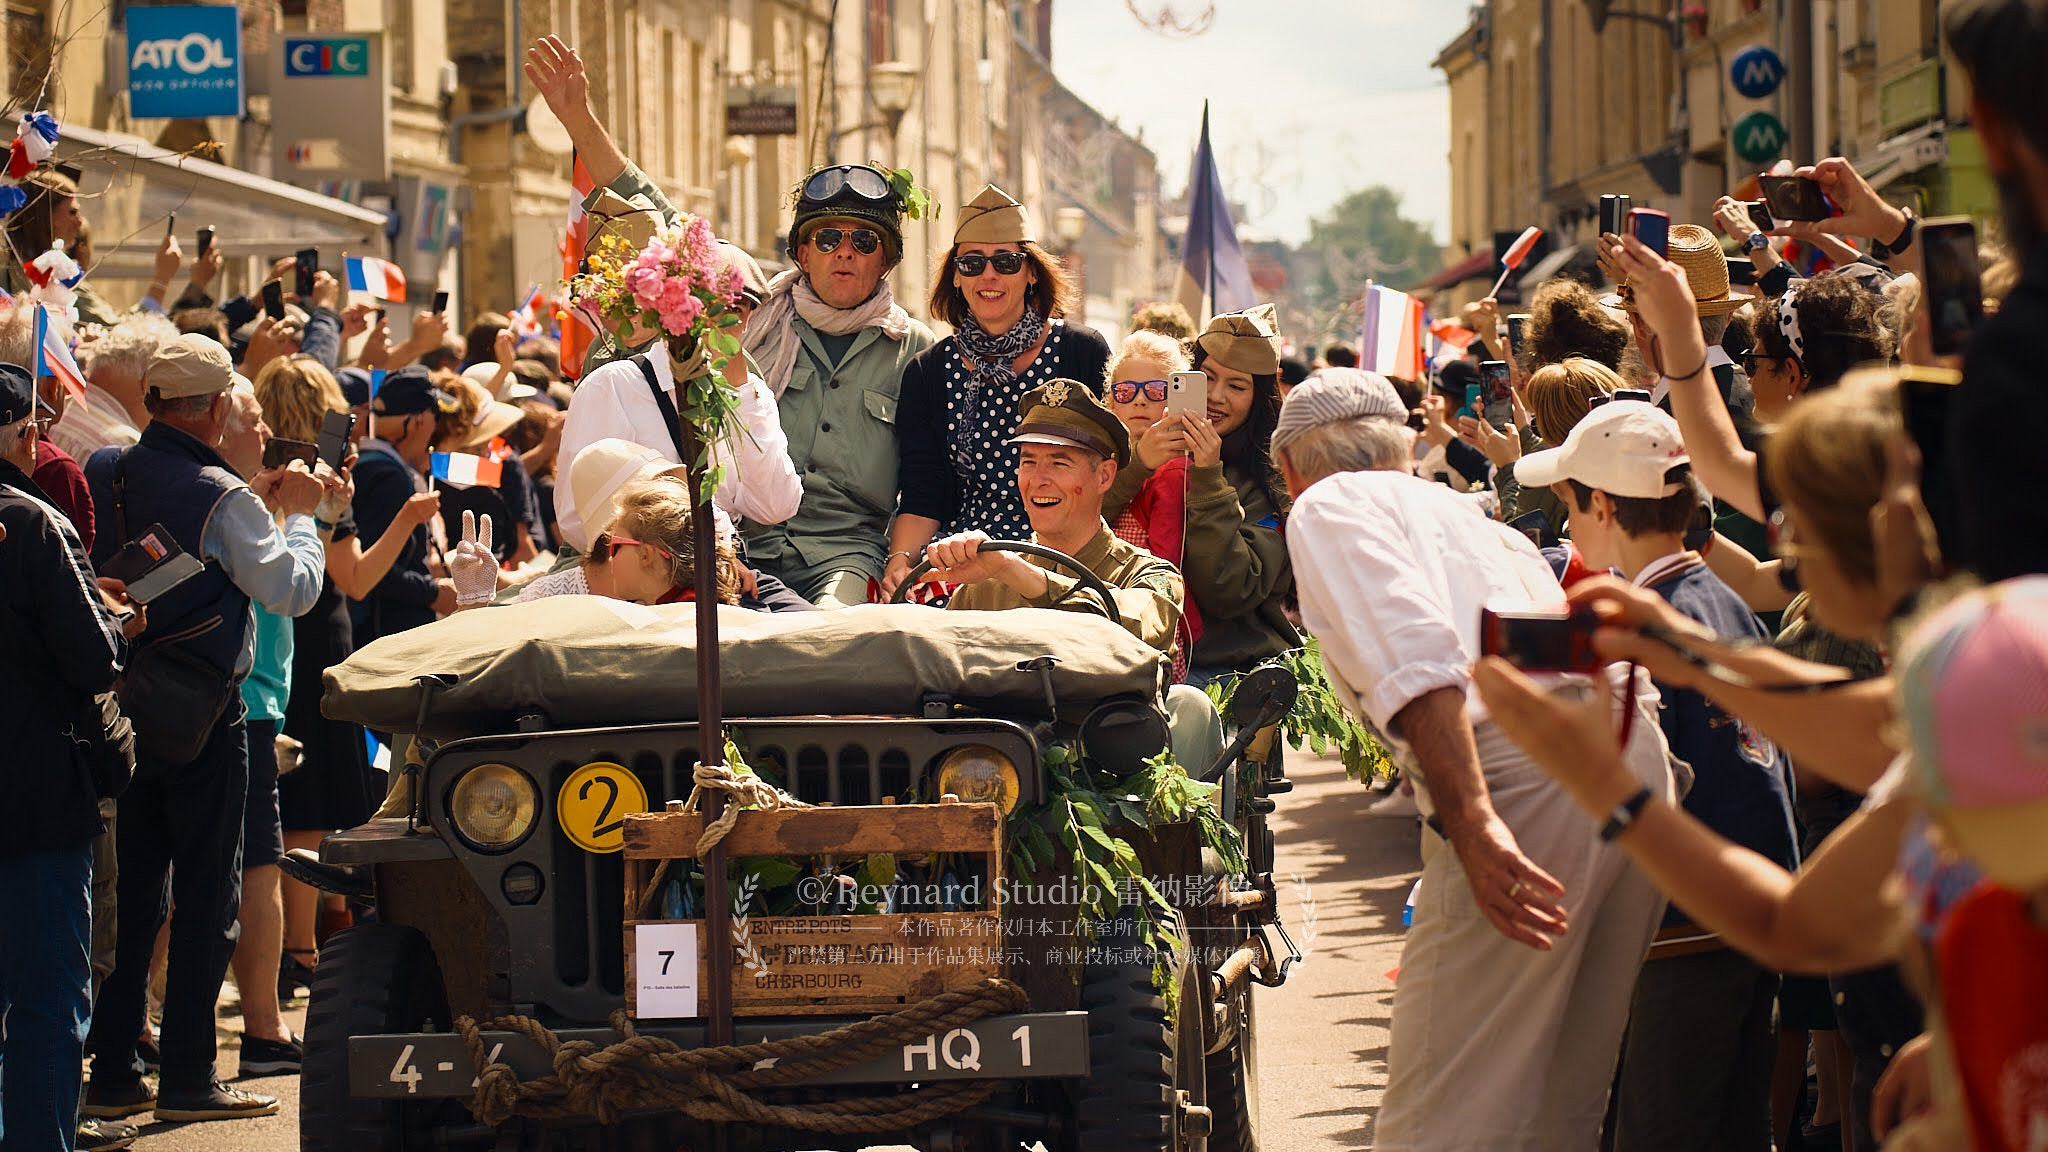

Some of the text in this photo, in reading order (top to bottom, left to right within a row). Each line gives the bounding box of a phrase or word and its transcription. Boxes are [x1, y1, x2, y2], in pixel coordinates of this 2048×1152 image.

[131, 33, 234, 75] ATOL
[291, 44, 360, 72] CIC
[1743, 60, 1774, 85] M
[1746, 125, 1778, 150] M
[579, 776, 625, 838] 2
[751, 918, 852, 935] ENTREPOTS
[658, 950, 675, 976] 7
[755, 973, 863, 989] CHERBOURG
[903, 1025, 1031, 1073] HQ 1
